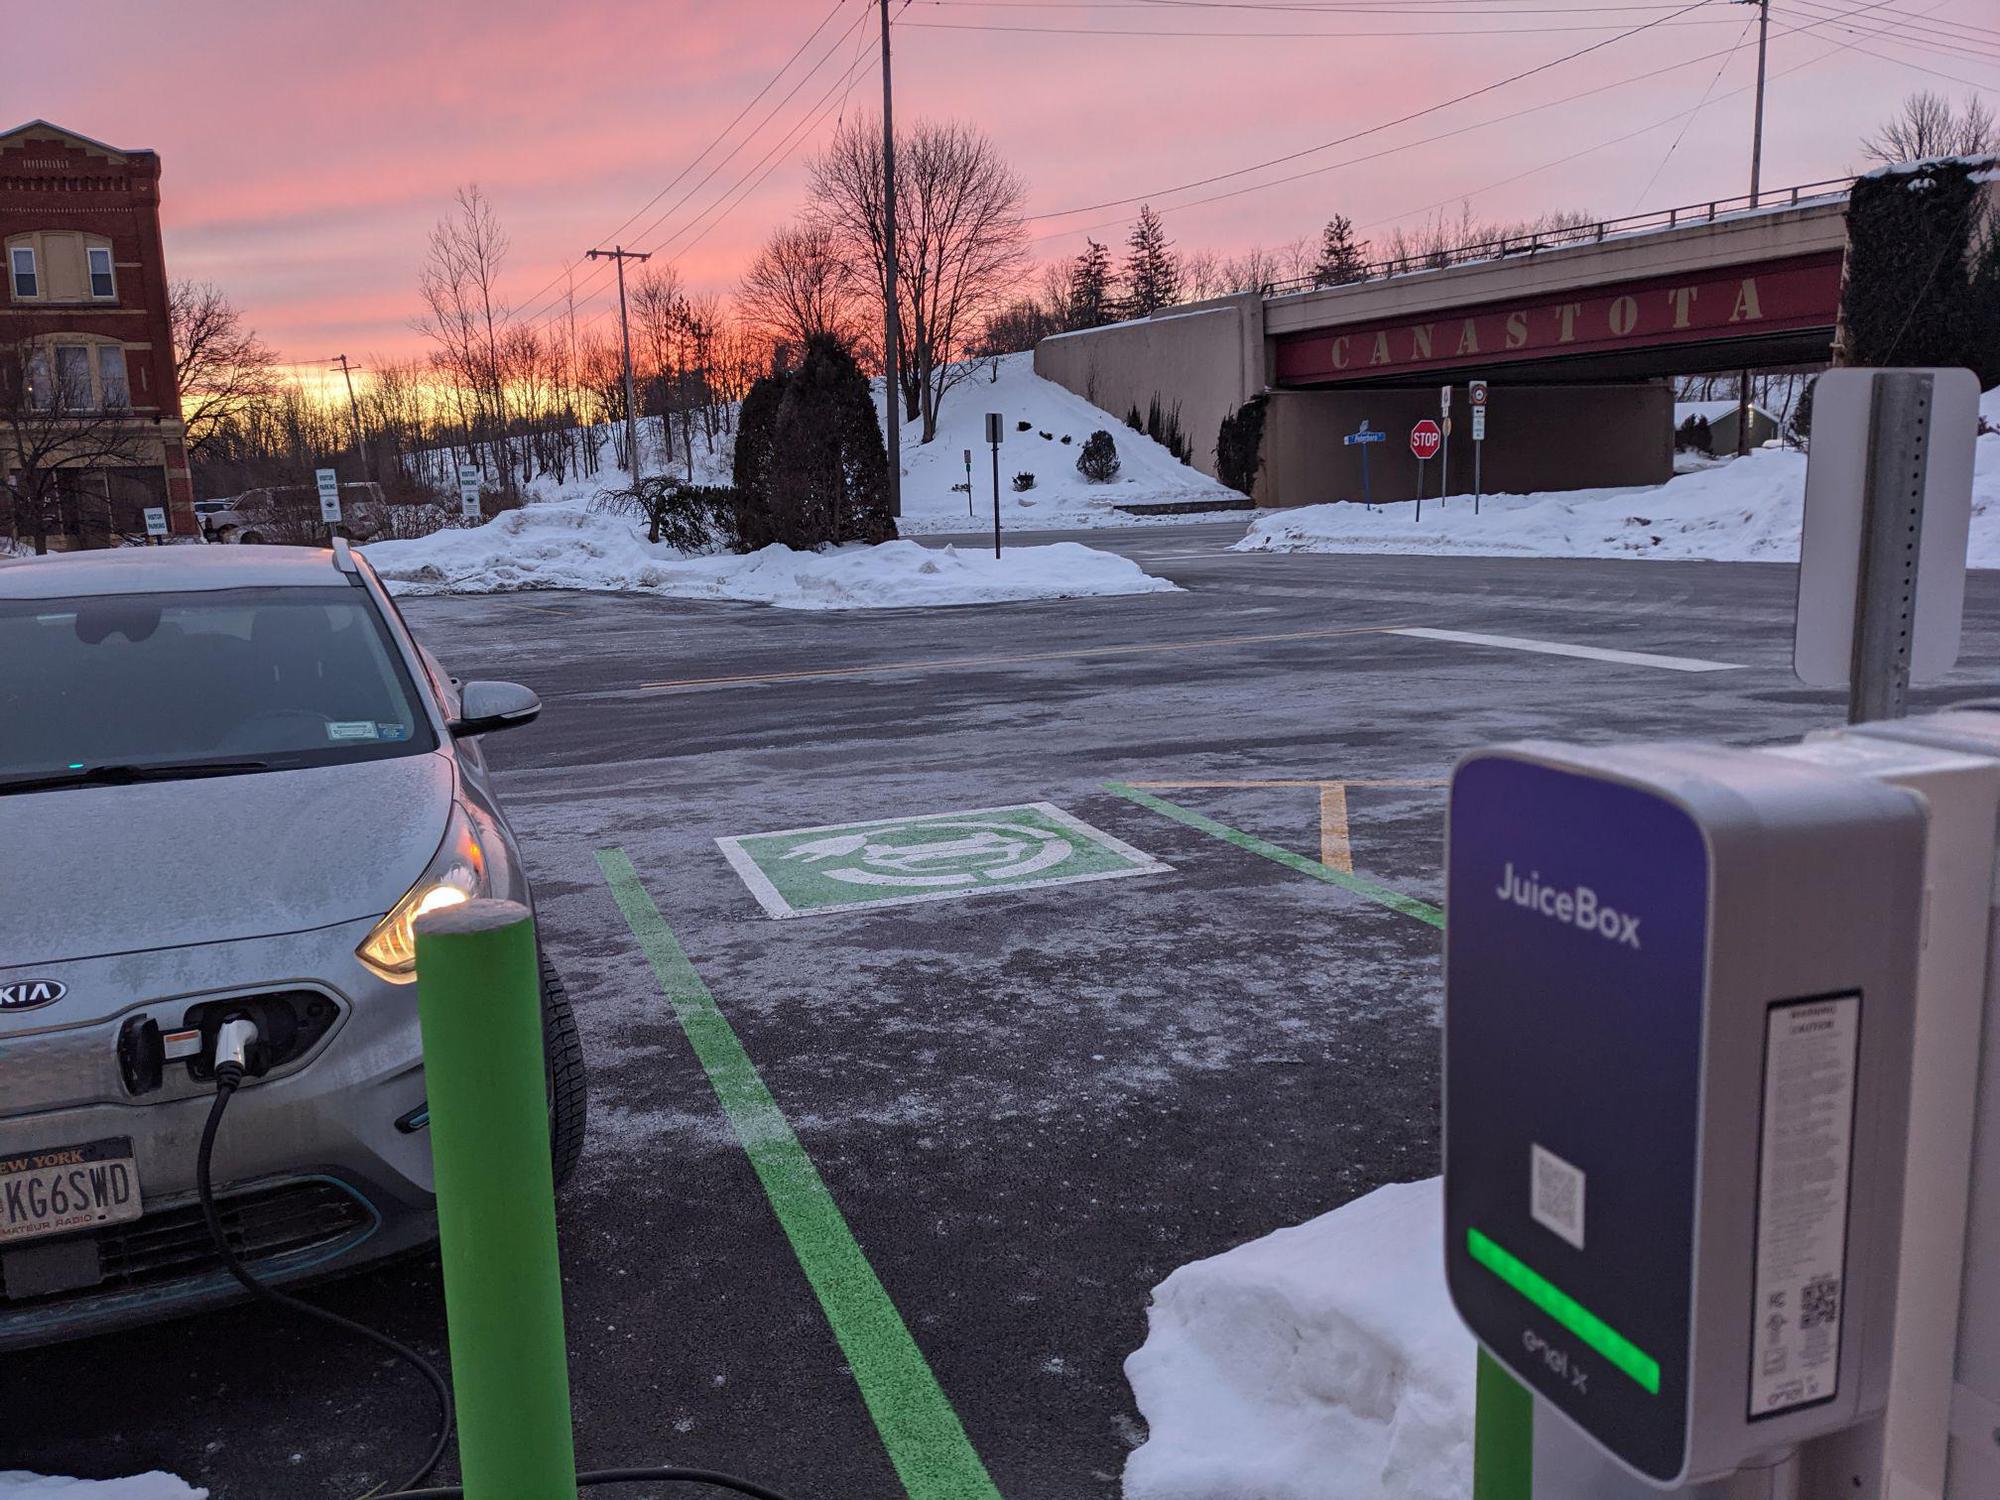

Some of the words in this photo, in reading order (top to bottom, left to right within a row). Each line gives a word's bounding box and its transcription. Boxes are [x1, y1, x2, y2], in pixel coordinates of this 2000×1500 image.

[1331, 278, 1763, 369] CANASTOTA
[1413, 432, 1439, 447] STOP
[1496, 861, 1641, 949] JuiceBox
[0, 983, 50, 1004] KIA
[0, 1158, 28, 1174] EW
[32, 1149, 84, 1168] YORK
[4, 1163, 130, 1223] KG6SWD
[0, 1222, 50, 1236] MATEUR
[56, 1214, 92, 1227] RADIO
